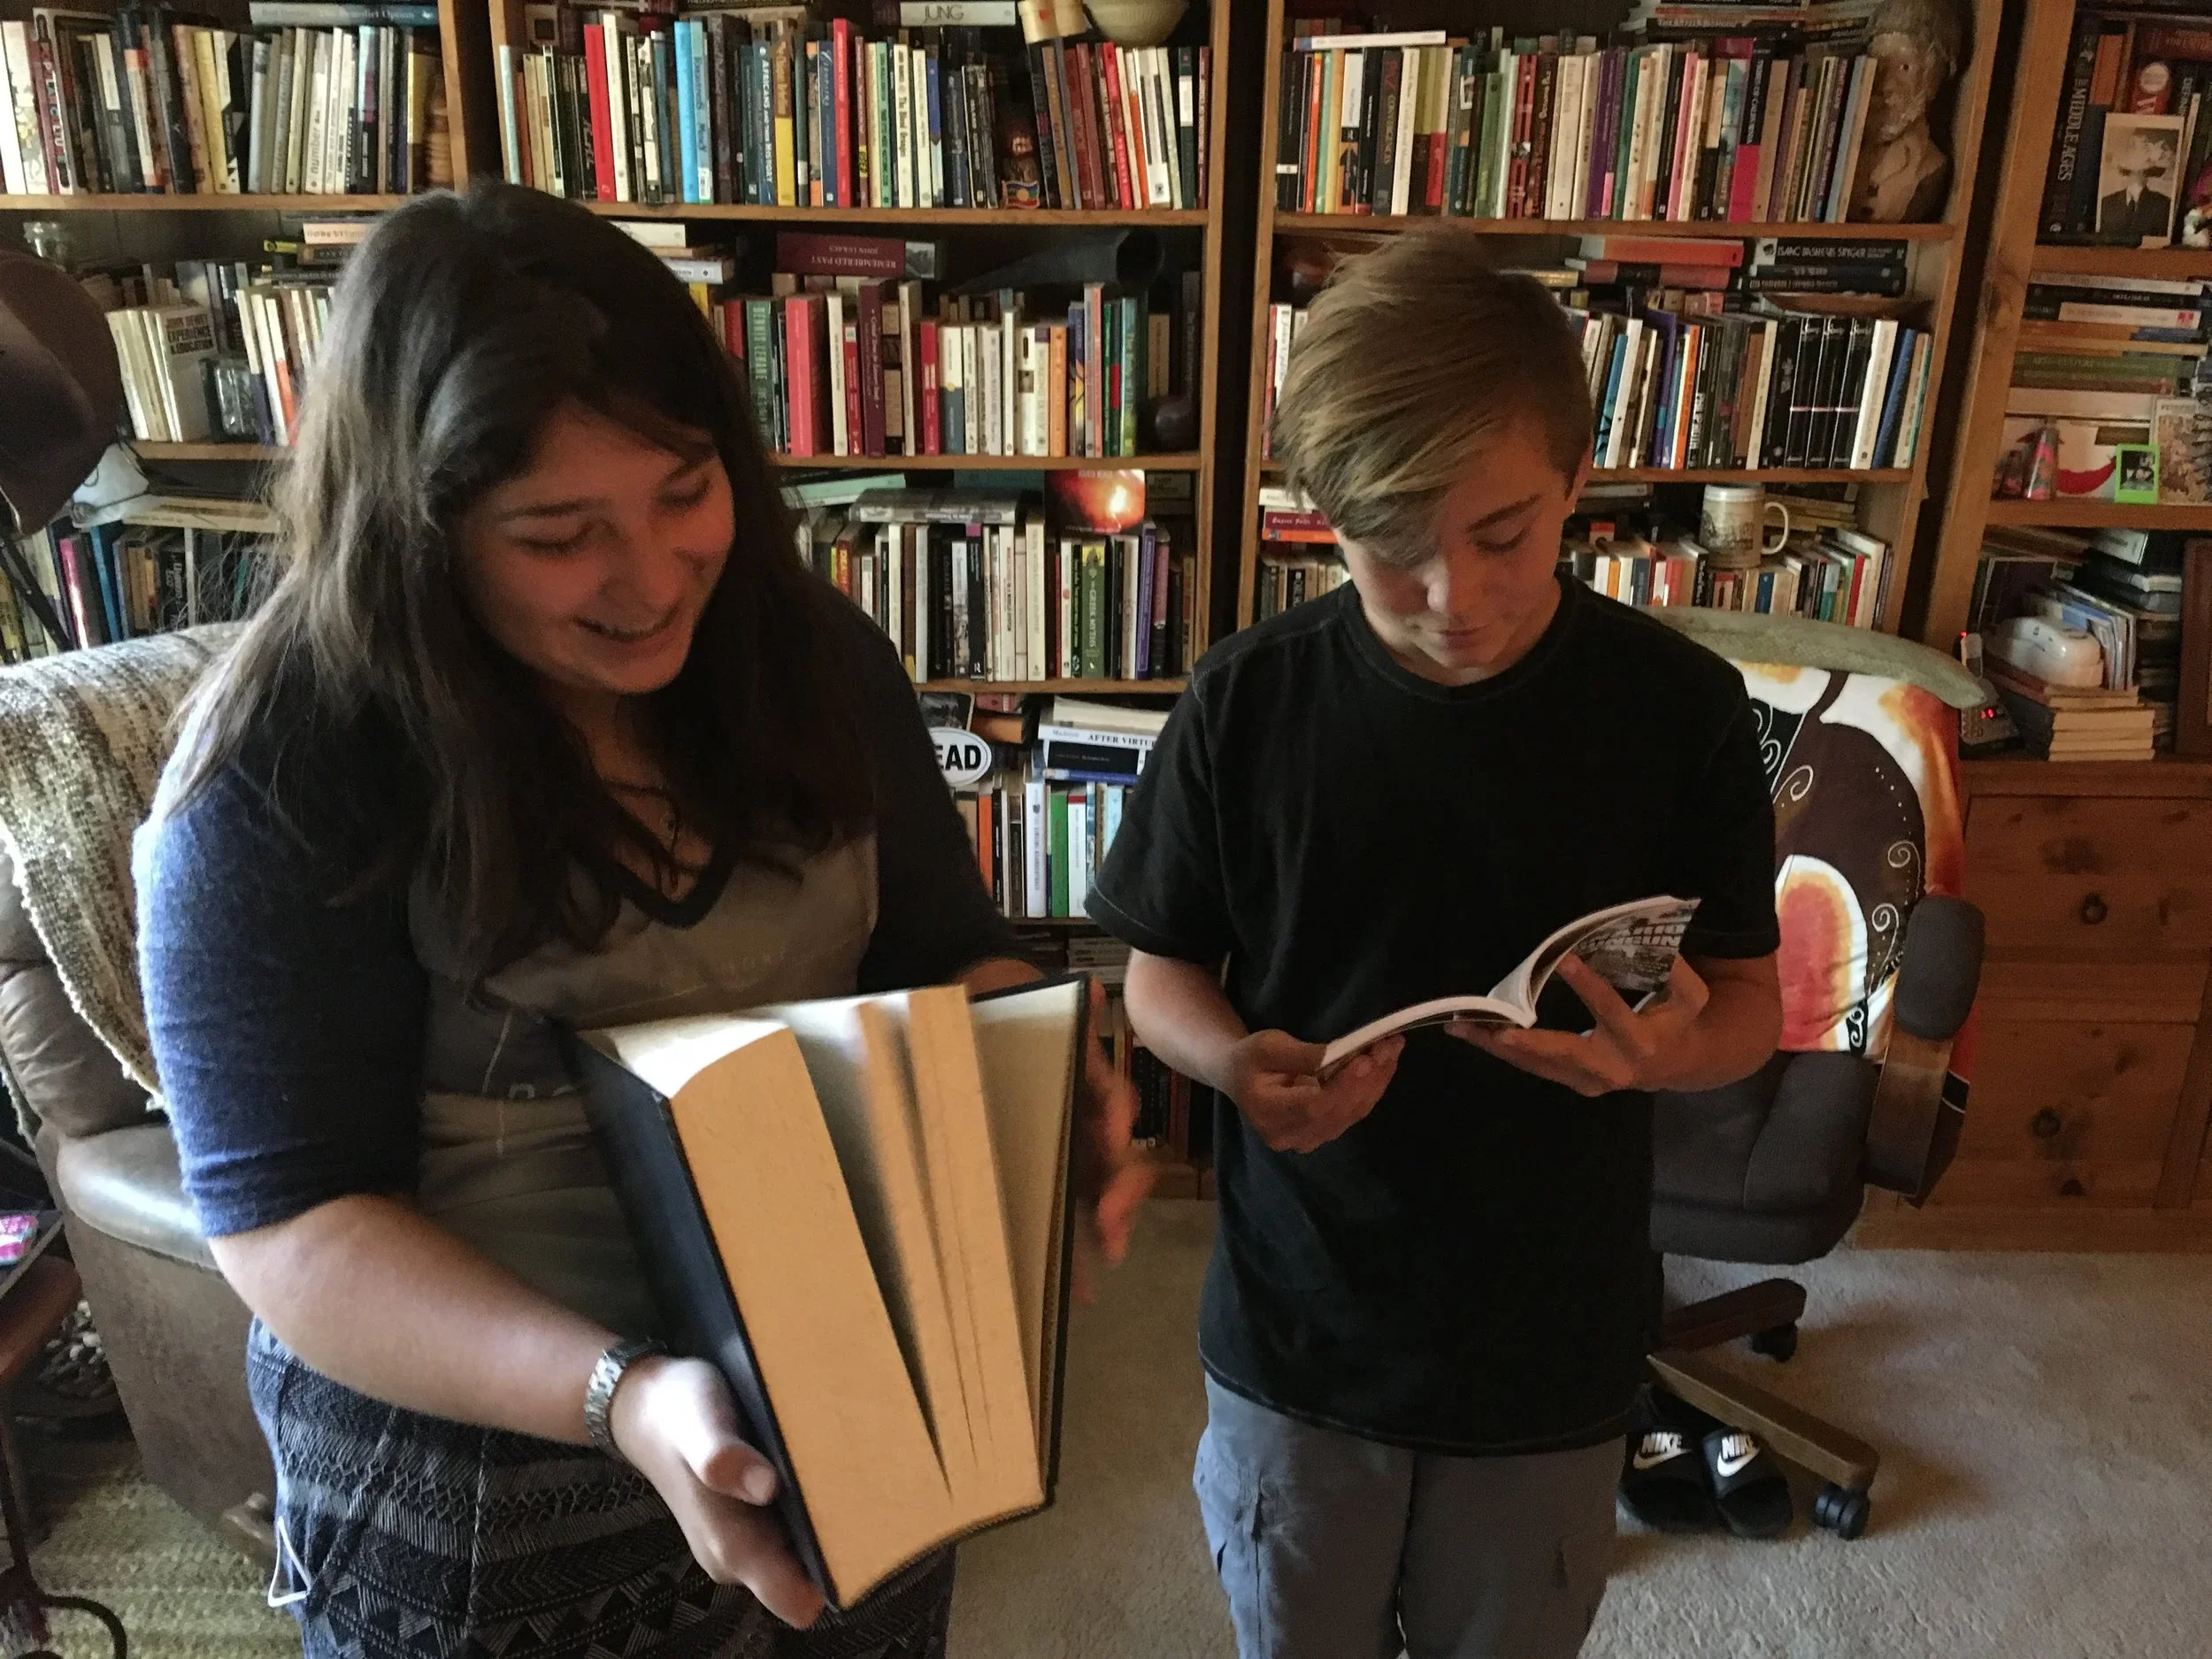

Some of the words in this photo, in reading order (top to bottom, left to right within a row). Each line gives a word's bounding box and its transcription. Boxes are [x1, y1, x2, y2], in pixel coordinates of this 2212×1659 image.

[923, 4, 964, 23] JUNG
[762, 59, 772, 109] AFRICANS
[2065, 87, 2088, 142] MIDDLE
[309, 127, 320, 174] number
[2057, 143, 2077, 181] AGES
[810, 255, 833, 265] PAST
[833, 256, 896, 269] REMEMBERED
[1838, 248, 1866, 258] SINGER
[166, 325, 211, 343] EXPERIENCE
[753, 307, 766, 342] DENNIS
[755, 346, 768, 380] LEHANE
[1087, 733, 1119, 744] AFTER
[933, 744, 981, 772] EAD
